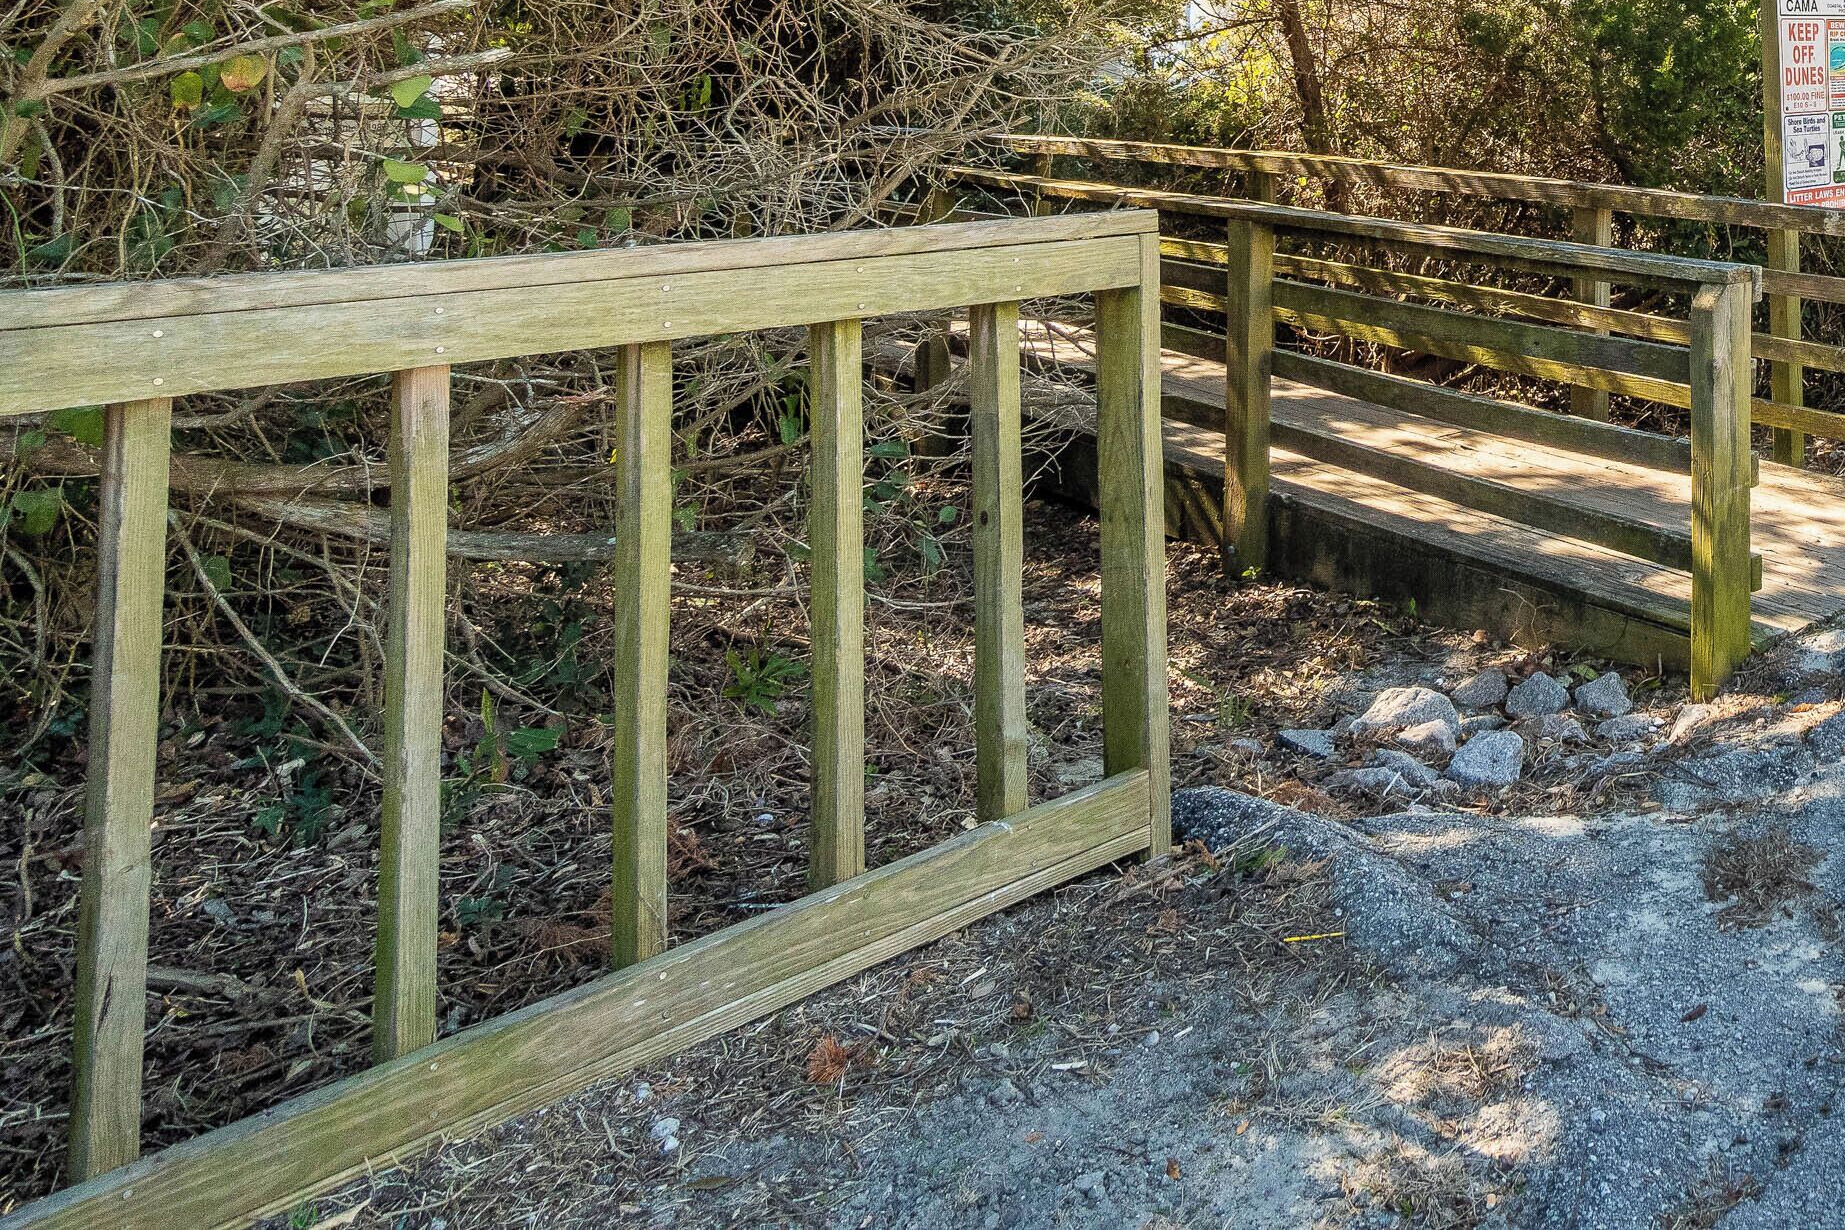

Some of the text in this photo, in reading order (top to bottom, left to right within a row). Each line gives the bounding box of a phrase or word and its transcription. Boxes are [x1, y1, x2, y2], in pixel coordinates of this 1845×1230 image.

[1786, 0, 1819, 12] CAMA
[1788, 22, 1819, 42] KEEP
[1792, 45, 1814, 64] OFF
[1786, 66, 1824, 86] DUNES
[1786, 91, 1825, 101] $100.00 FINE
[1788, 116, 1826, 126] Shore Birds and
[1803, 125, 1821, 133] Turtles
[1789, 192, 1813, 203] LITTER
[1815, 190, 1834, 200] LAWS
